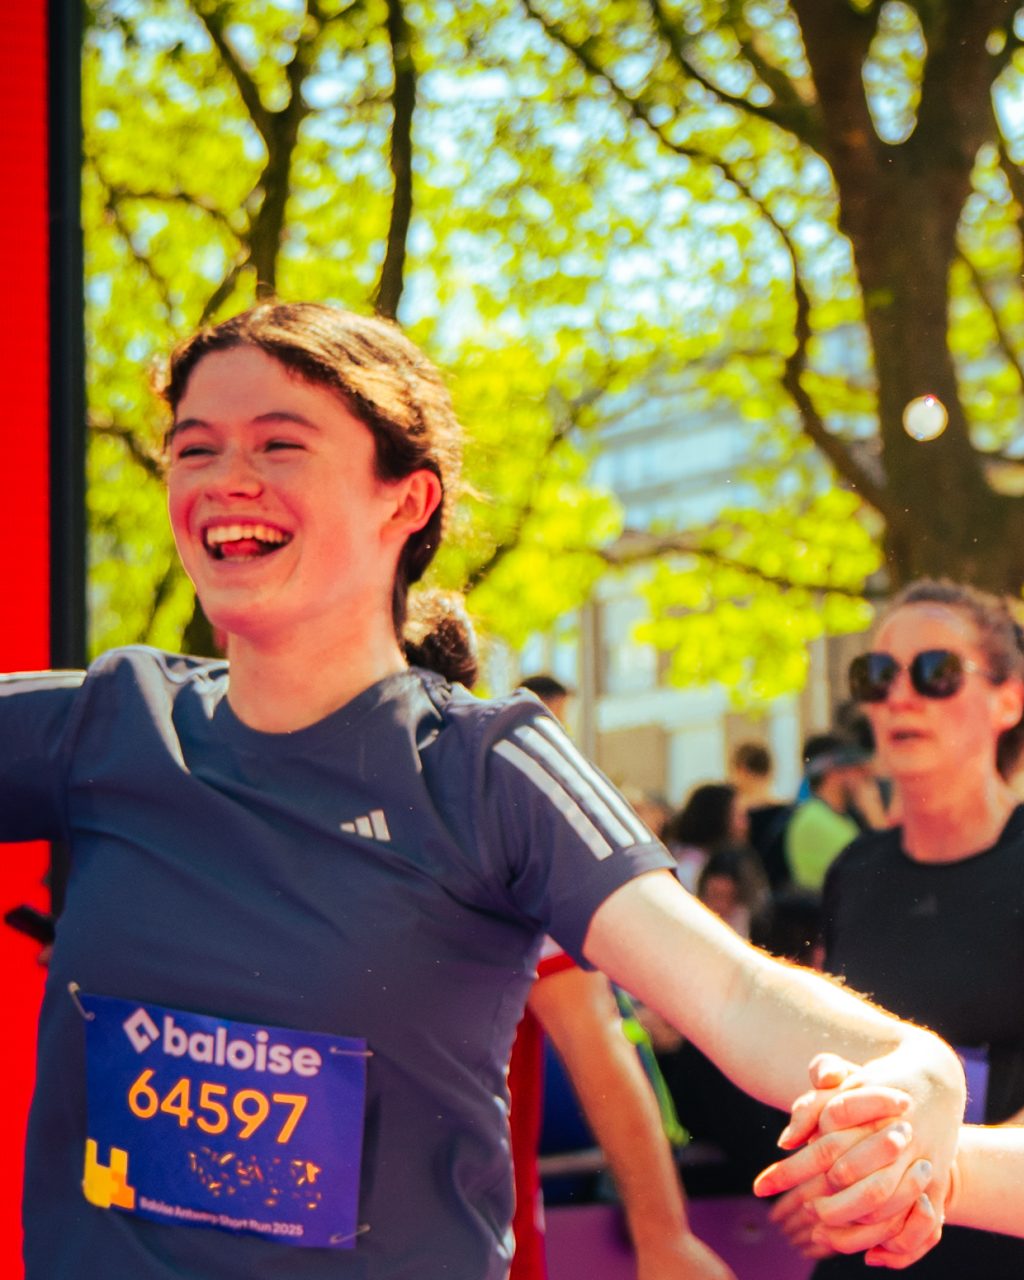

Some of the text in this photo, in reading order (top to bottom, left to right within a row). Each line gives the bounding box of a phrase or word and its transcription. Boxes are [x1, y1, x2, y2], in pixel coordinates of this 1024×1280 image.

[163, 1015, 322, 1076] baloise
[128, 1069, 308, 1143] 64597
[139, 1197, 304, 1236] Baloise Antwerp Short Run 2025
